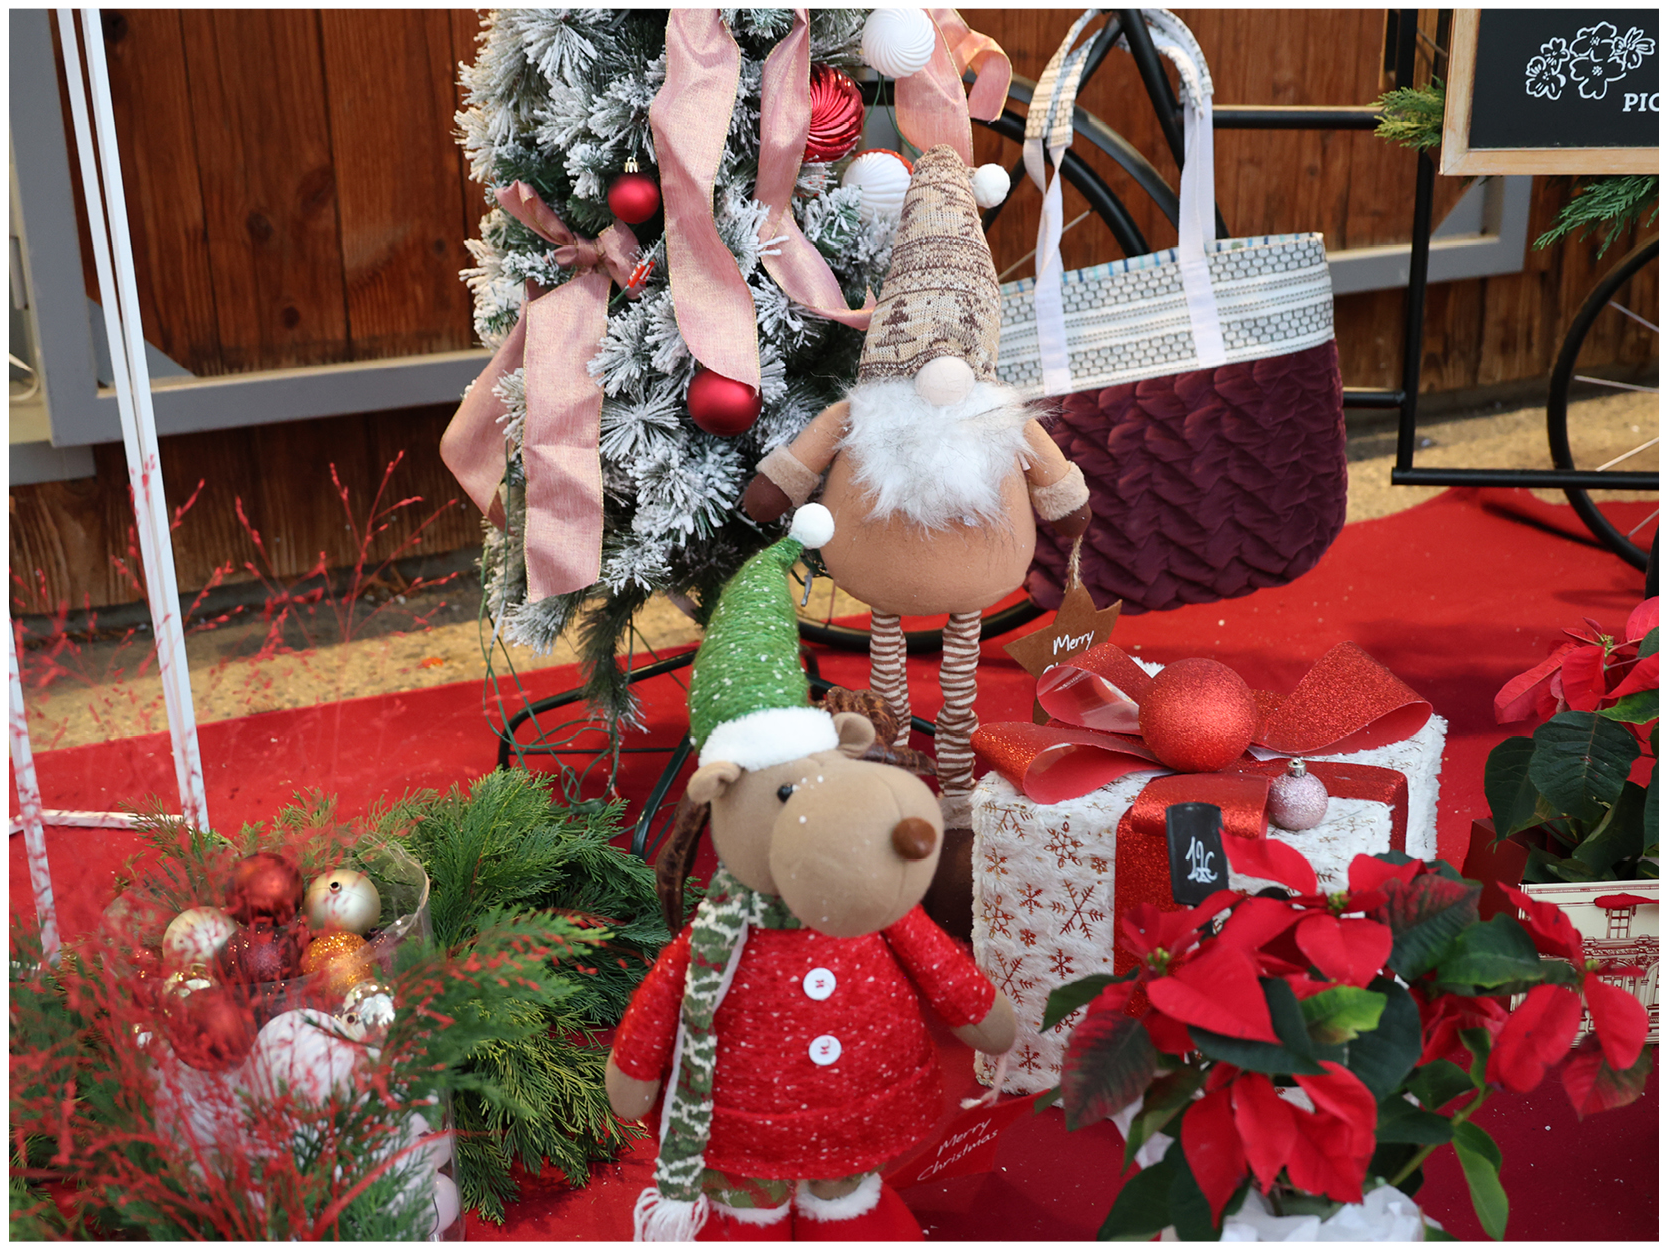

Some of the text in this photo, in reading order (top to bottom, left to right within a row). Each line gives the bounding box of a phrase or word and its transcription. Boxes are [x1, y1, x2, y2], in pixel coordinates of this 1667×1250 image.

[1053, 630, 1094, 655] Merry
[917, 1130, 998, 1181] Christmas
[937, 1118, 991, 1157] Merry
